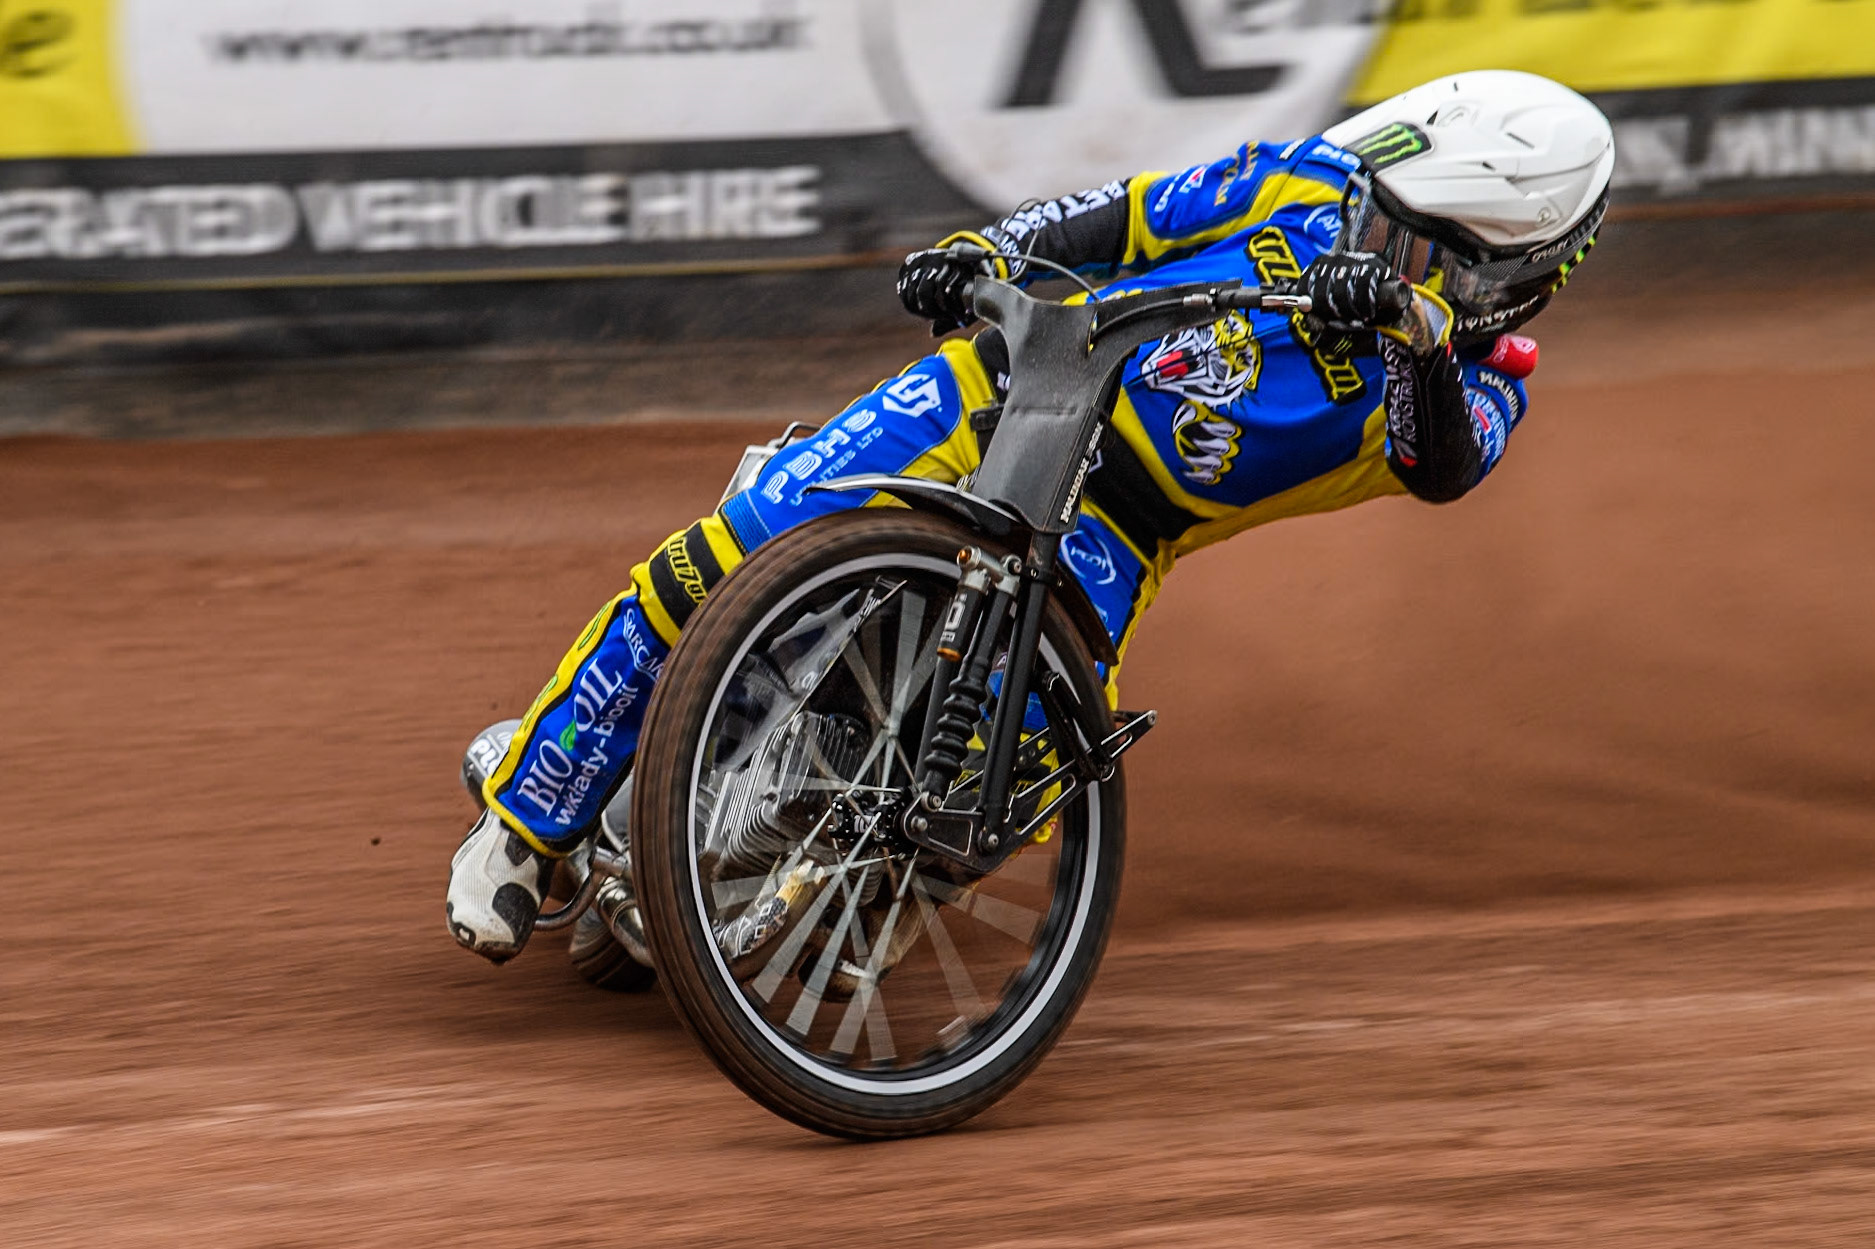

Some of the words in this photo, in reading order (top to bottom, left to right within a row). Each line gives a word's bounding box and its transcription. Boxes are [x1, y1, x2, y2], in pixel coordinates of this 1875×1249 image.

[299, 175, 629, 251] VEHICLE
[630, 164, 823, 241] HIRE
[761, 408, 877, 505] PBHS
[857, 425, 884, 449] LTD
[517, 739, 574, 817] BIO
[573, 657, 623, 733] OIL
